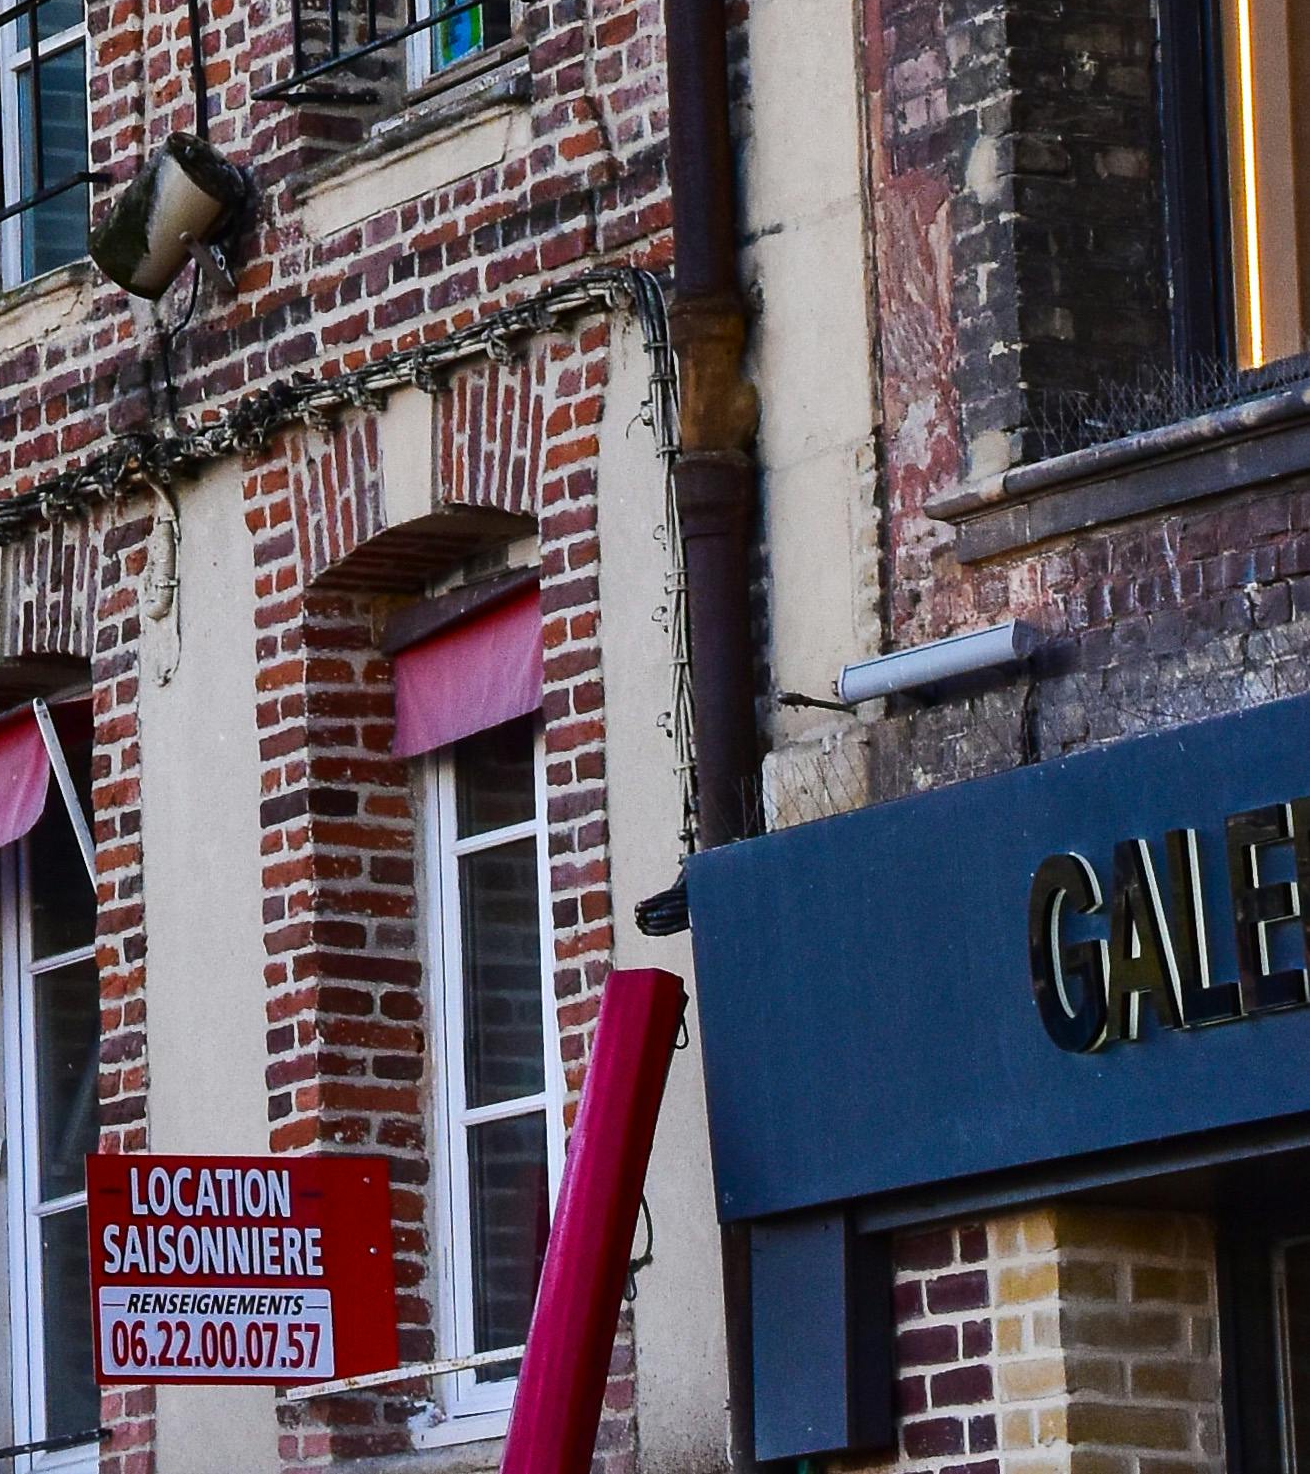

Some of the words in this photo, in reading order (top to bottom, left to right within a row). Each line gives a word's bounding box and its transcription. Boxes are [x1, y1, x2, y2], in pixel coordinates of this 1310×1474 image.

[130, 1166, 291, 1217] LOCATION
[103, 1224, 325, 1276] SAISONNIERE
[126, 1293, 304, 1317] RENSEIGNEMENTS
[111, 1320, 321, 1369] 06.22.00.07.57
